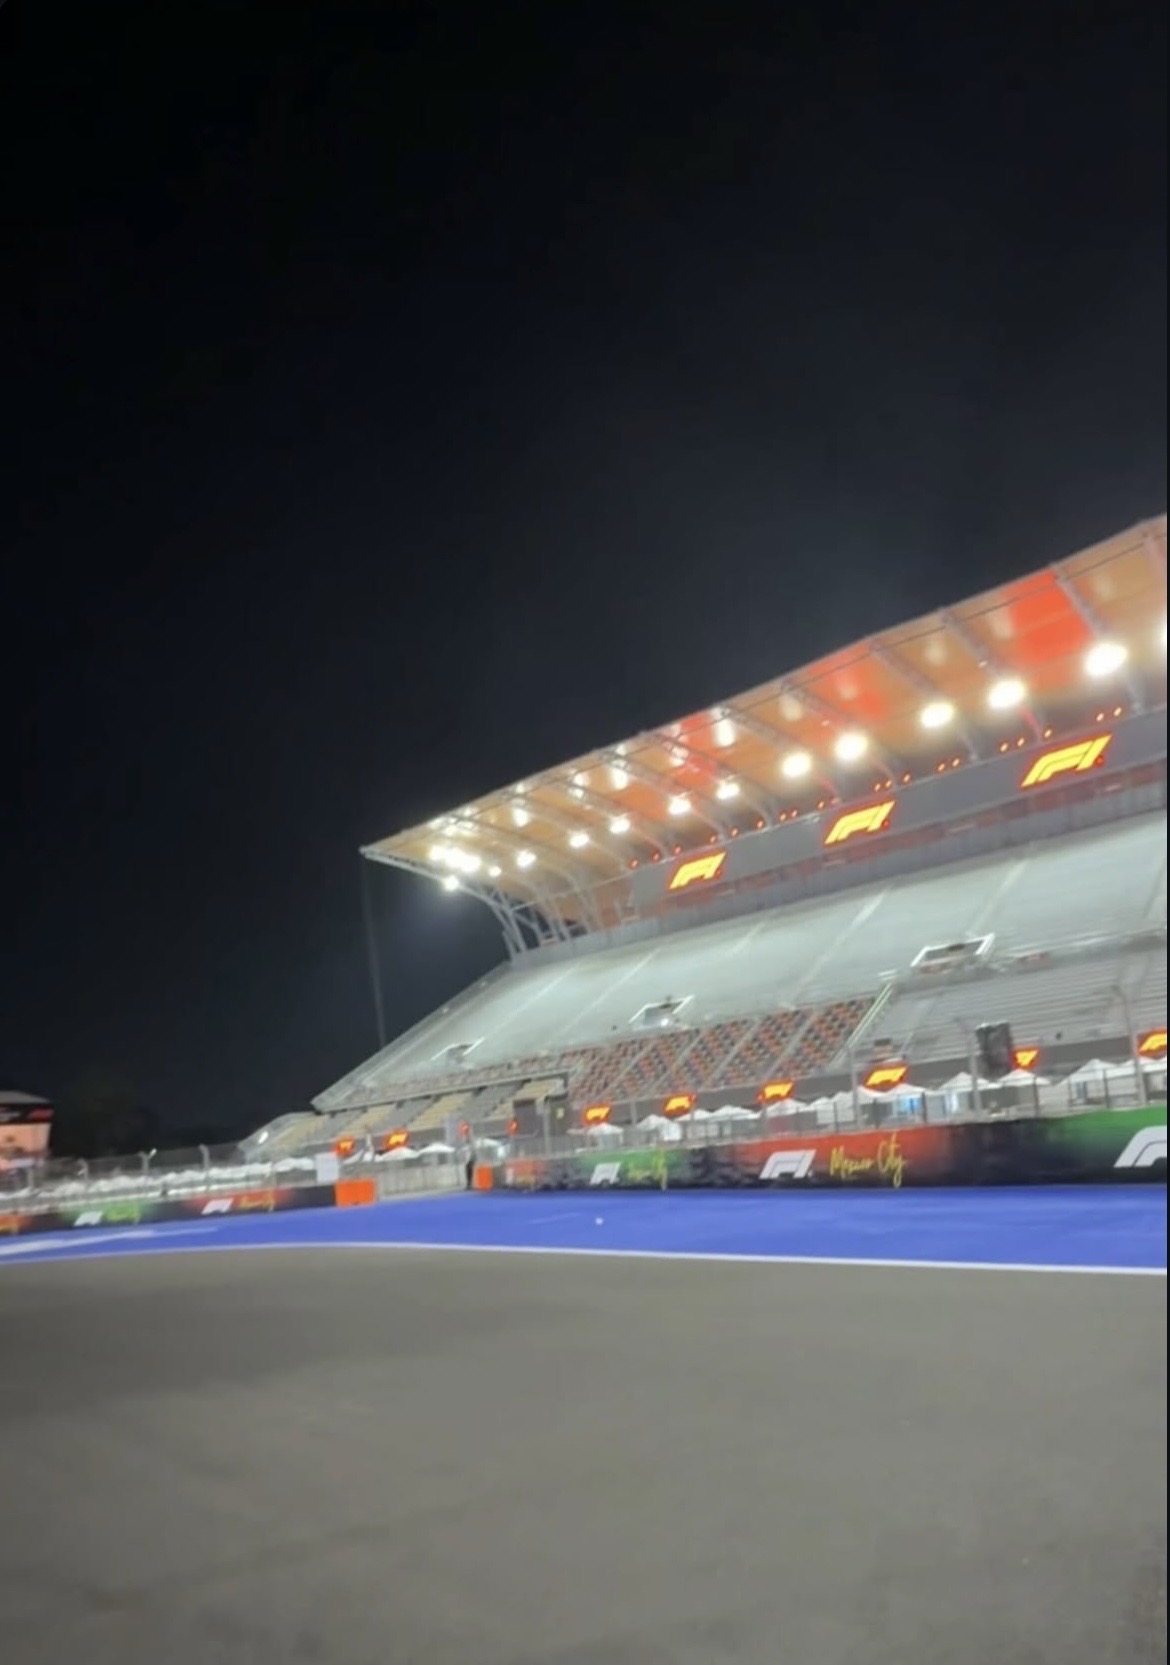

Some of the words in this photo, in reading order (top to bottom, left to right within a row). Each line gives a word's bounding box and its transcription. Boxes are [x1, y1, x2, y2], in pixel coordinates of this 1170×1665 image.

[1020, 734, 1112, 789] F1
[823, 800, 896, 846] F1
[668, 851, 727, 890] F1
[759, 1149, 816, 1180] F1
[1113, 1124, 1168, 1168] F
